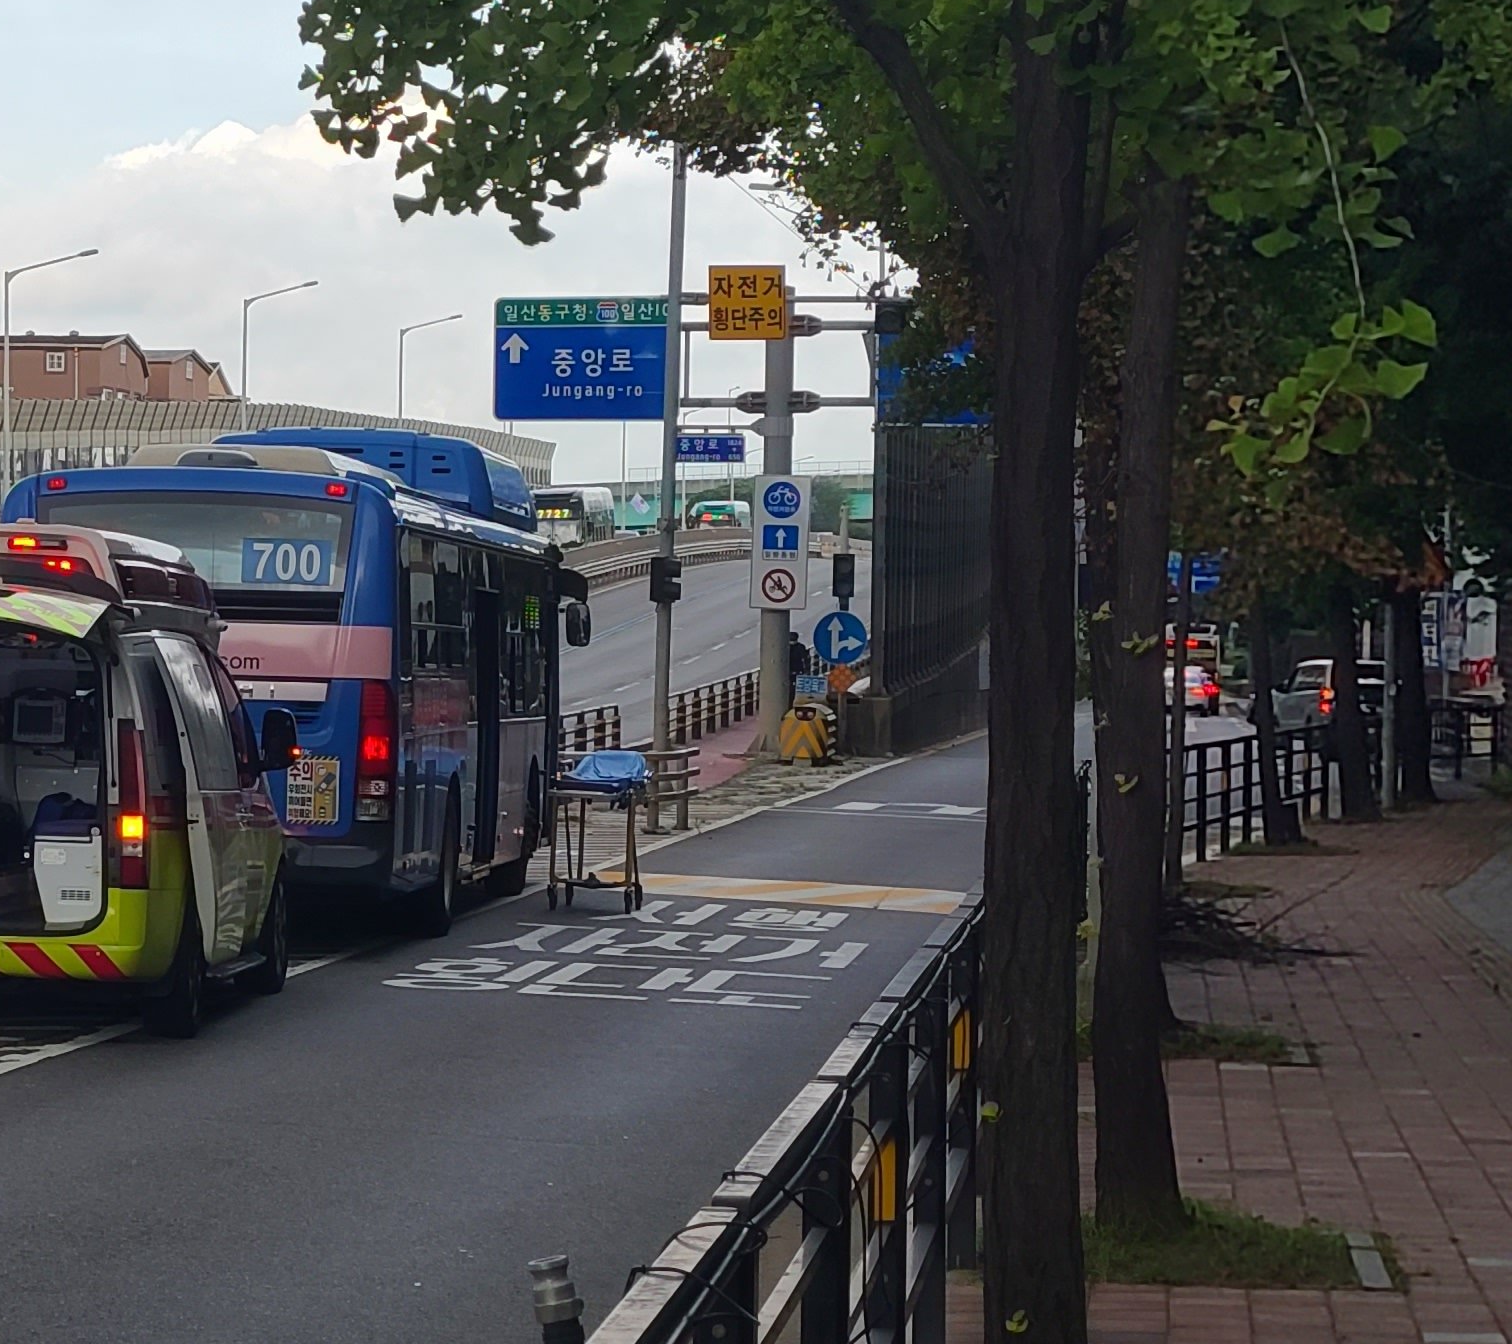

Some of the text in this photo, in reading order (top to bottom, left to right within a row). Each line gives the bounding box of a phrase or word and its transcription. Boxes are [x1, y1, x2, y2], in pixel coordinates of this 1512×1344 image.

[713, 274, 782, 298] 자전거
[713, 307, 782, 331] 횡단주의
[551, 349, 634, 377] 중앙로
[542, 384, 643, 399] Jungang-ro
[680, 439, 719, 452] 중앙로
[538, 509, 569, 519] 7727
[253, 543, 321, 582] 700
[289, 761, 314, 782] 주의
[590, 900, 850, 932] 서행
[467, 922, 870, 969] 자전거
[381, 957, 833, 1010] 횡단도
